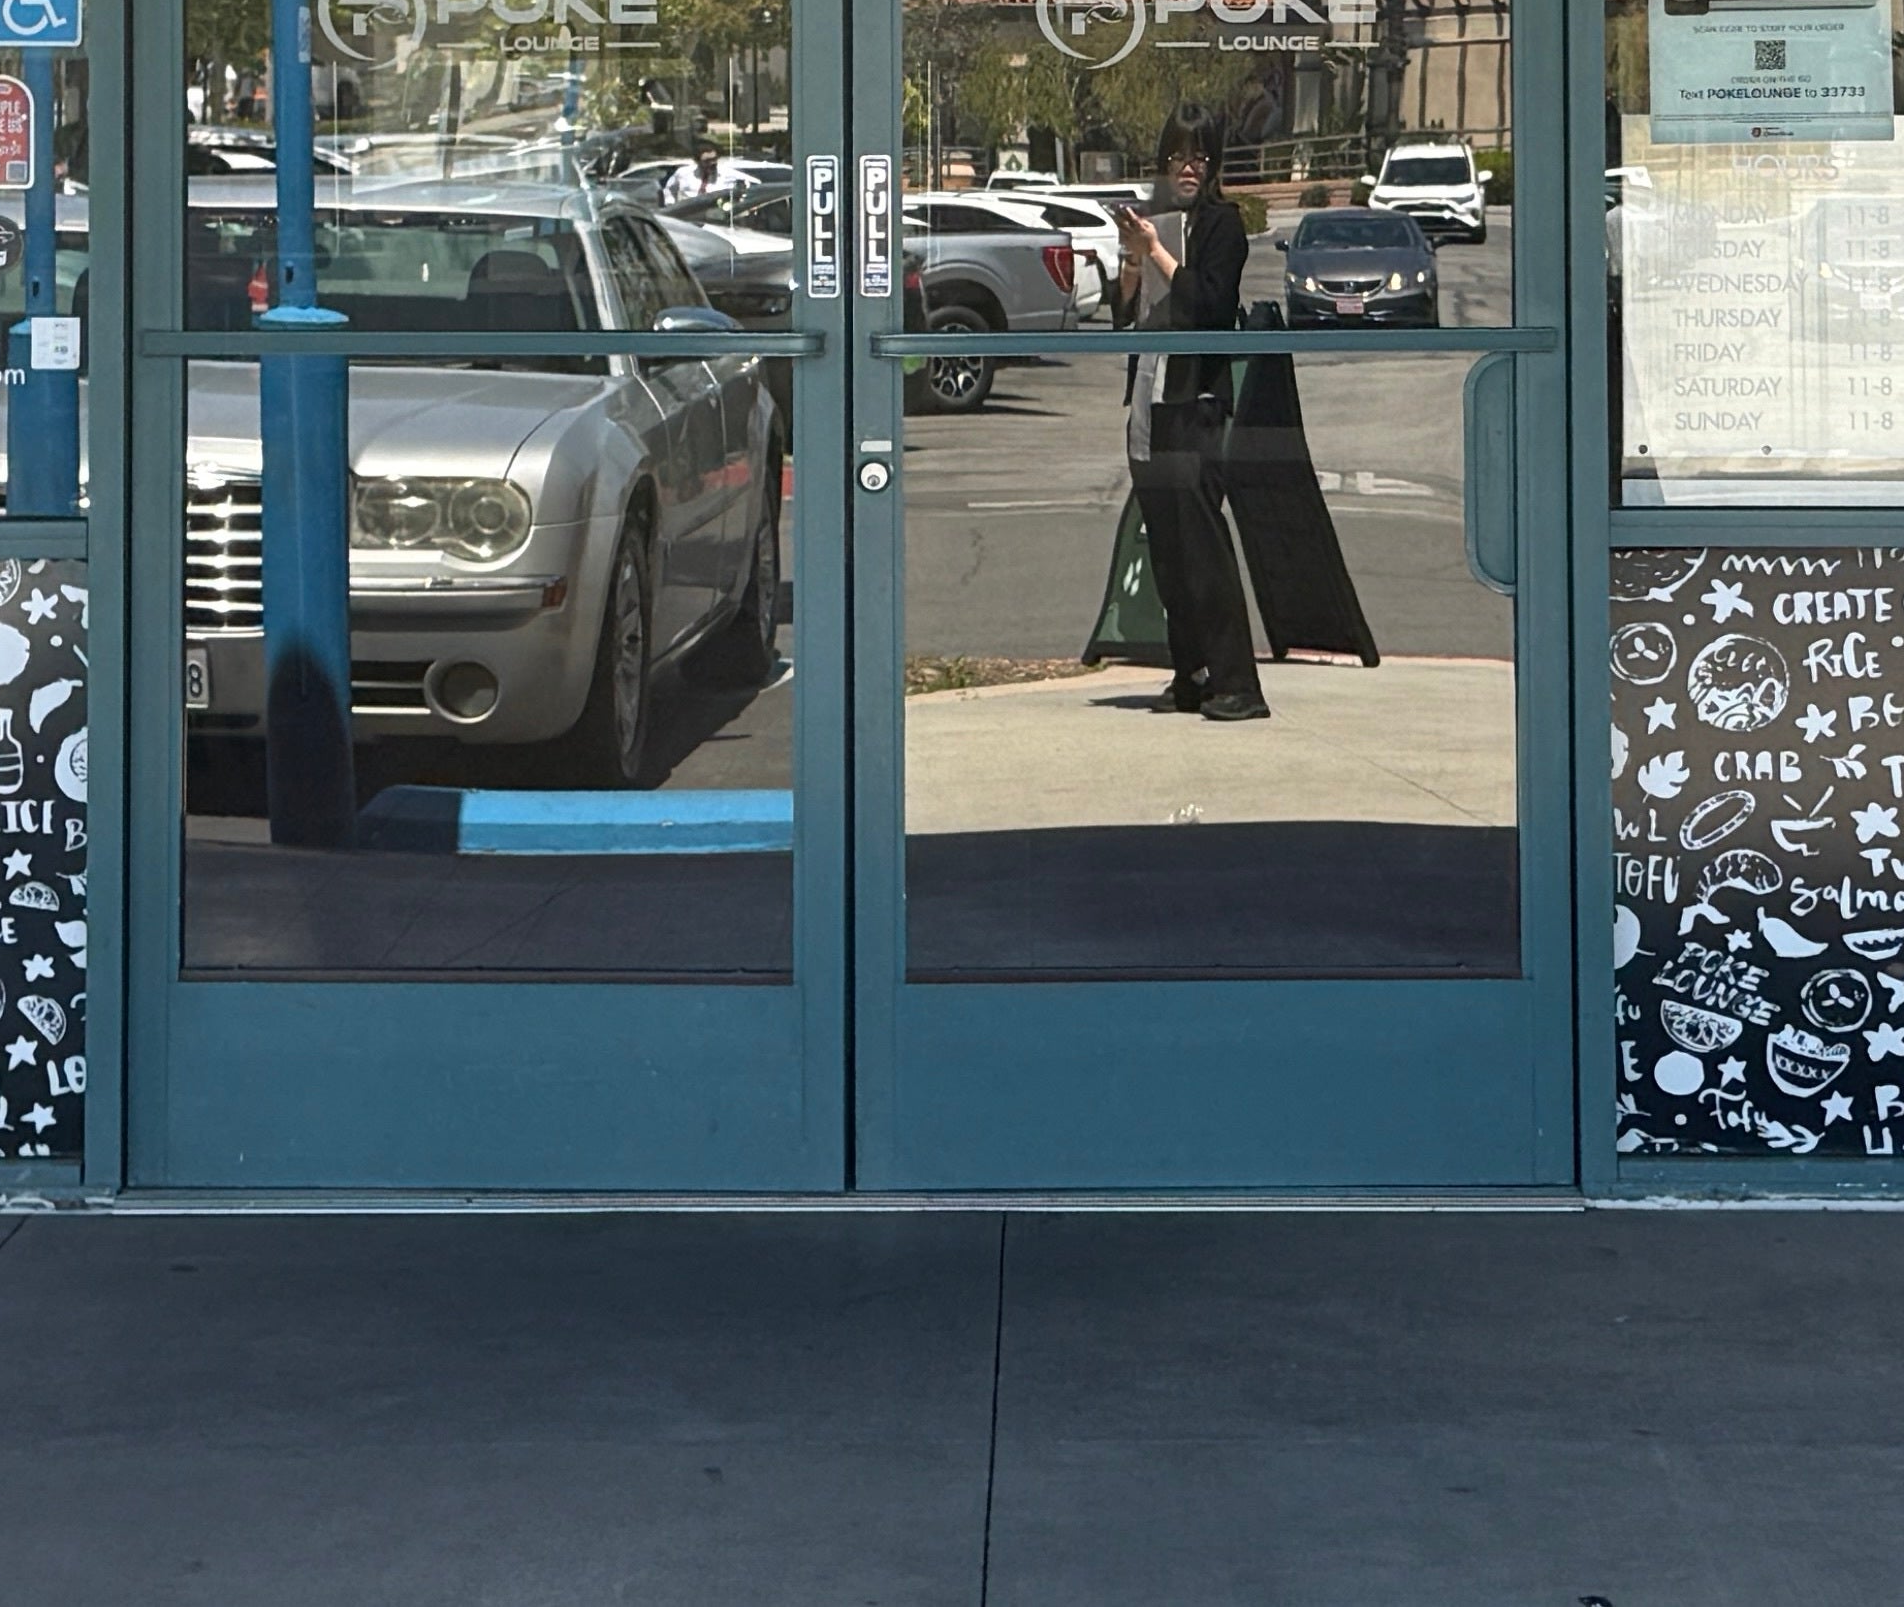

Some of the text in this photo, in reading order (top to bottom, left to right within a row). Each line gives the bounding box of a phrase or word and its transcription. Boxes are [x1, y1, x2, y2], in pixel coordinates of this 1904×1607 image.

[500, 35, 600, 52] LOUNGE
[1218, 35, 1319, 52] LOUNGE
[1680, 87, 1866, 100] Text POKELOUNGE to 33733
[1732, 154, 1840, 181] HOURS
[812, 167, 833, 262] PULL
[865, 167, 887, 262] PULL
[1845, 205, 1890, 224] 11-8
[1846, 240, 1890, 259] 11-8
[1674, 274, 1808, 294] WEDNESDAY
[1673, 308, 1782, 328] THURSDAY
[1674, 343, 1893, 362] FRIDAY 11-8
[1674, 376, 1893, 397] SATURDAY 11-8
[1675, 411, 1894, 431] SUNDAY 11-8
[1773, 588, 1893, 624] CREATE
[1803, 632, 1882, 682] RICE
[1715, 751, 1801, 782] CRAB
